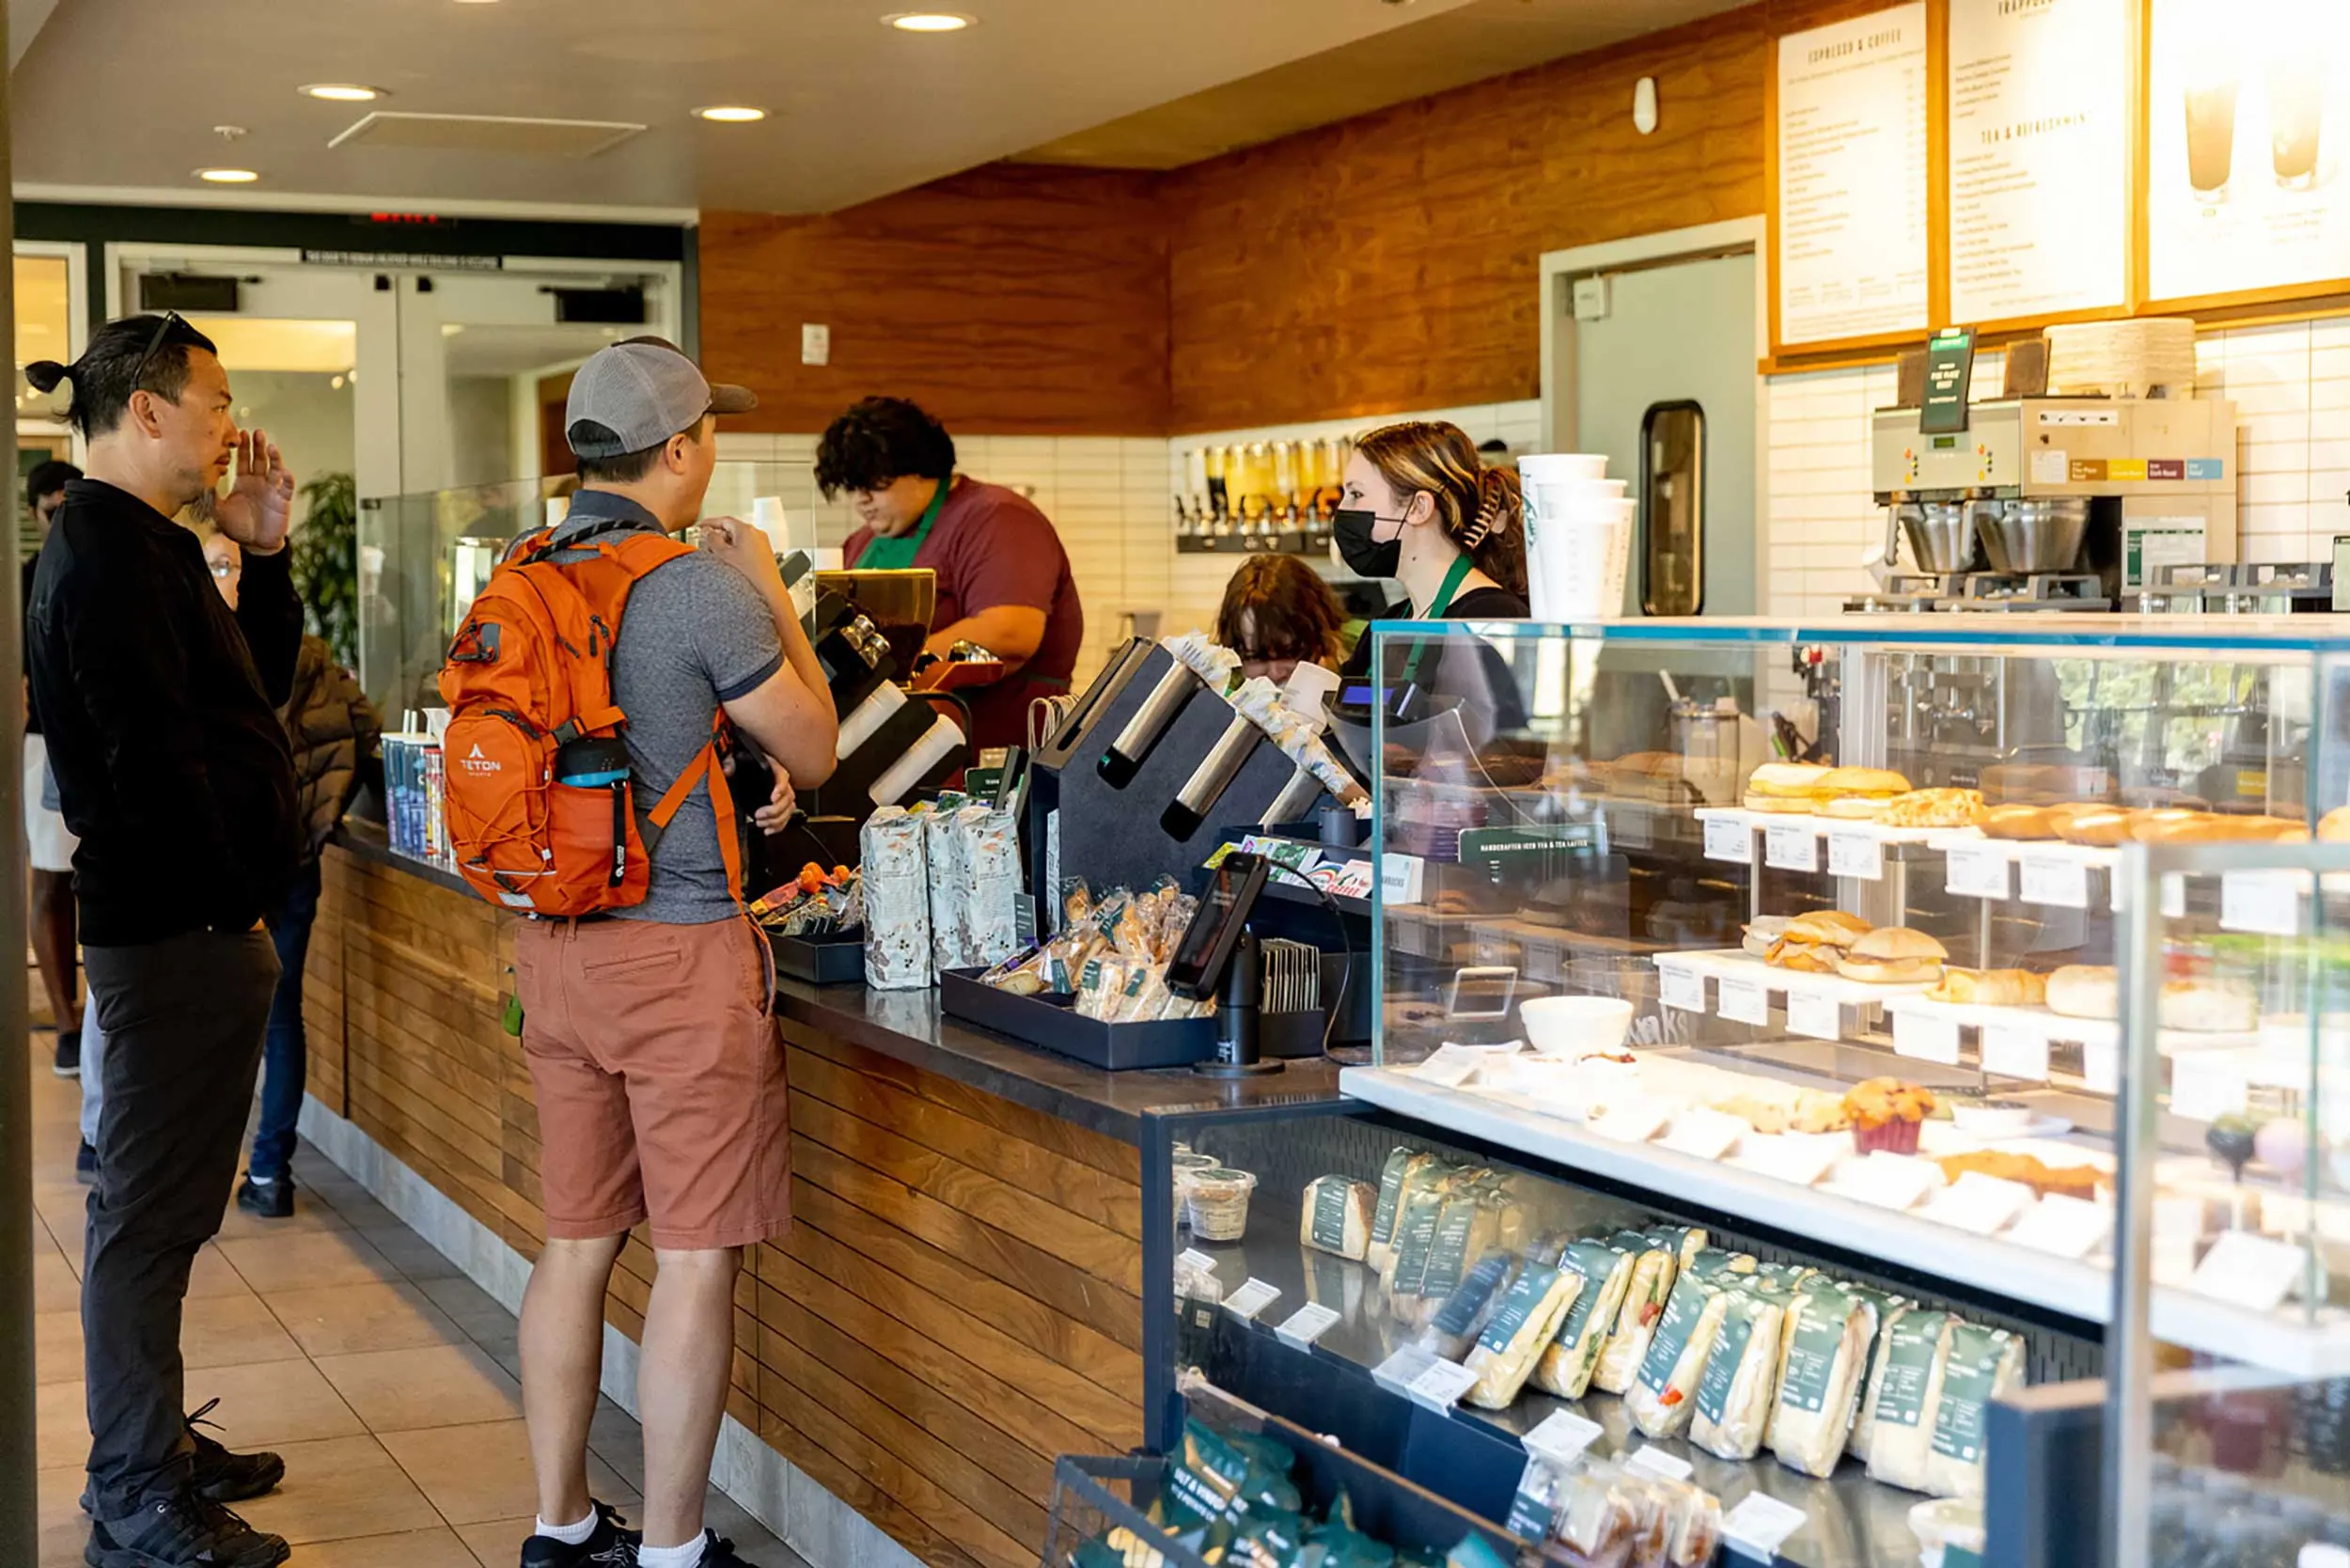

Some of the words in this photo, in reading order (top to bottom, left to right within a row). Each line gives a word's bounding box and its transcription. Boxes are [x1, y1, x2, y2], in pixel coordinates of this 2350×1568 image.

[1808, 41, 1854, 65] ESPRESSO
[1868, 28, 1901, 50] COFFEE
[459, 758, 502, 772] TETON
